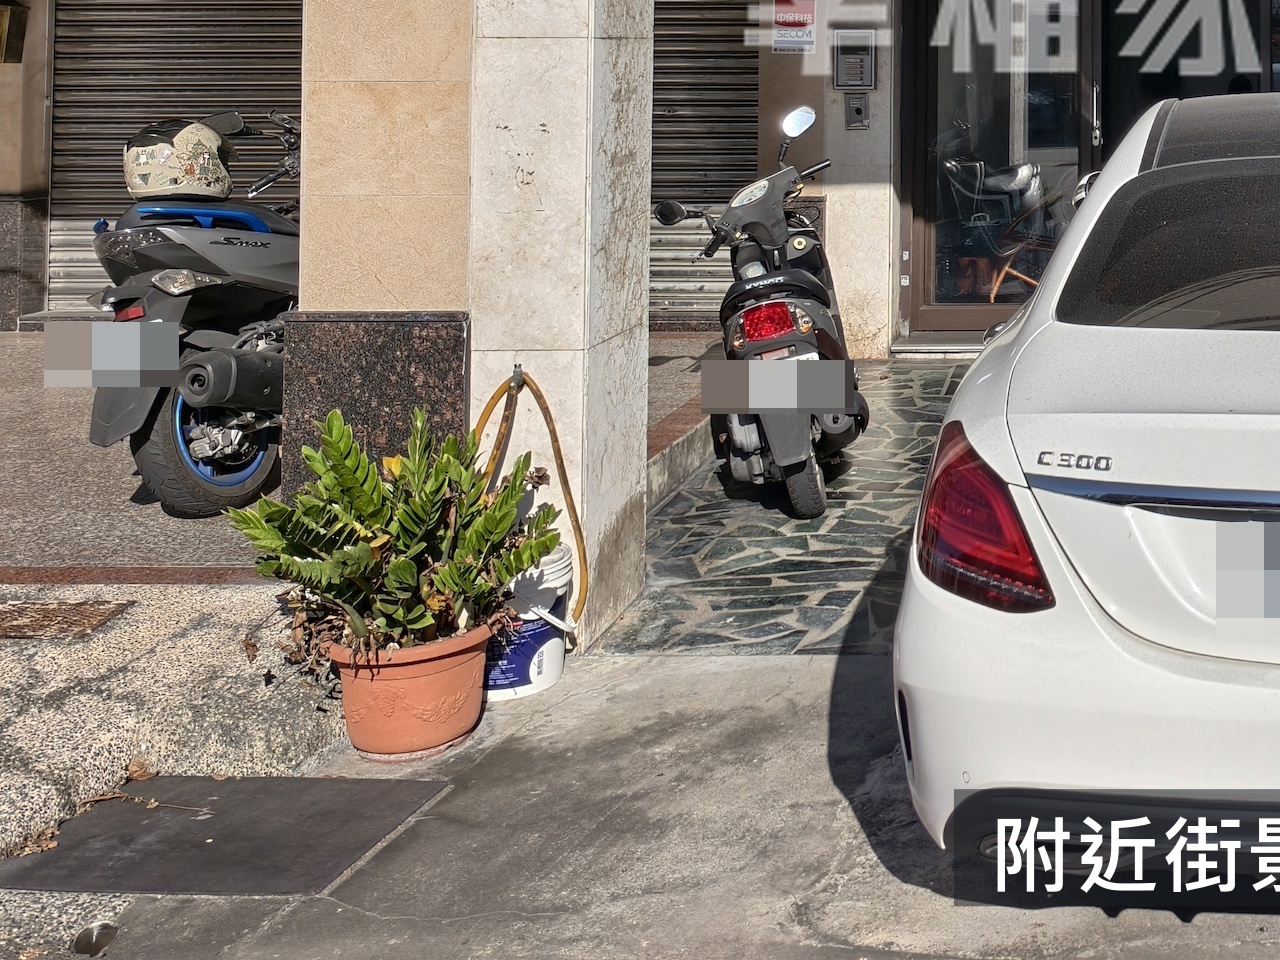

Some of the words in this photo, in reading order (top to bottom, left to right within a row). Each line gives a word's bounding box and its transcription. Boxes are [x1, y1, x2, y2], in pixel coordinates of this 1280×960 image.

[776, 12, 813, 23] 中保科技
[776, 29, 812, 39] SECOM
[745, 276, 785, 290] KYMCO
[1037, 451, 1055, 466] C
[1057, 453, 1113, 471] 300
